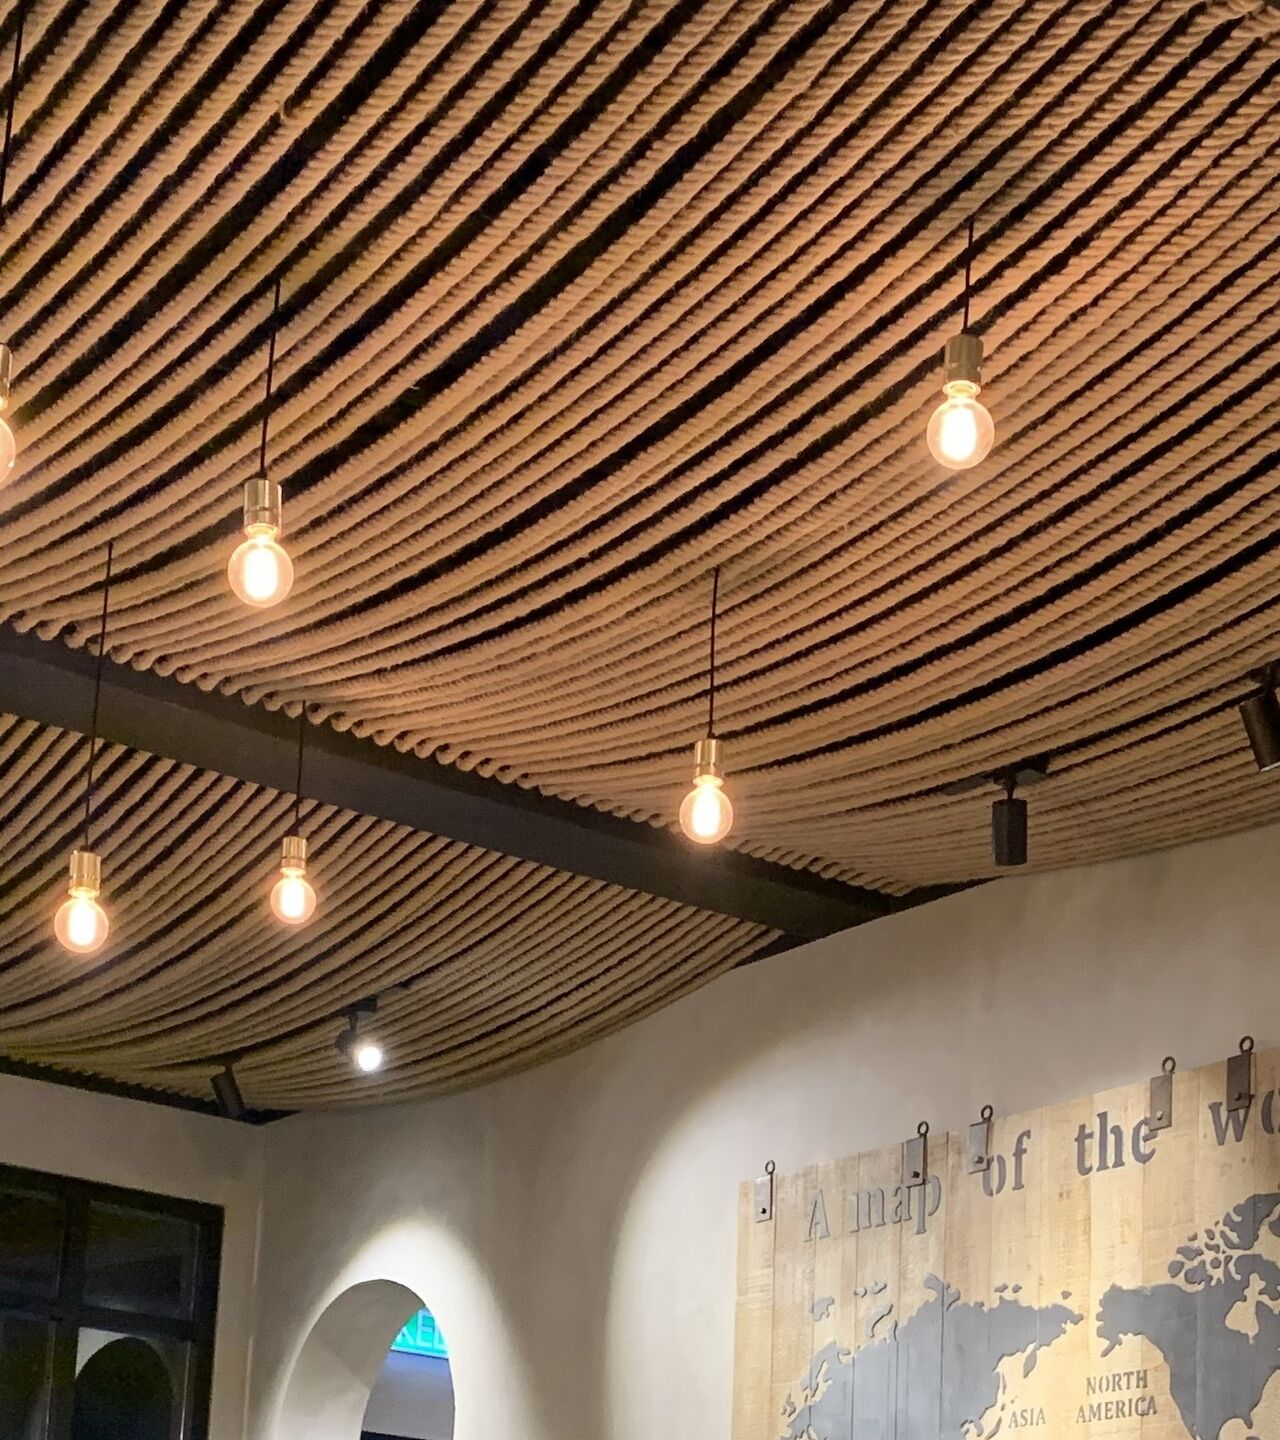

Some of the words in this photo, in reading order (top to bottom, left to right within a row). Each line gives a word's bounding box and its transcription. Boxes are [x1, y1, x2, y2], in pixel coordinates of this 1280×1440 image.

[803, 1187, 831, 1243] A
[850, 1174, 942, 1235] map
[982, 1129, 1032, 1197] of
[1074, 1110, 1159, 1177] the
[1085, 1368, 1149, 1396] NORTH
[1008, 1406, 1047, 1429] ASIA
[1075, 1395, 1158, 1424] AMERICA
